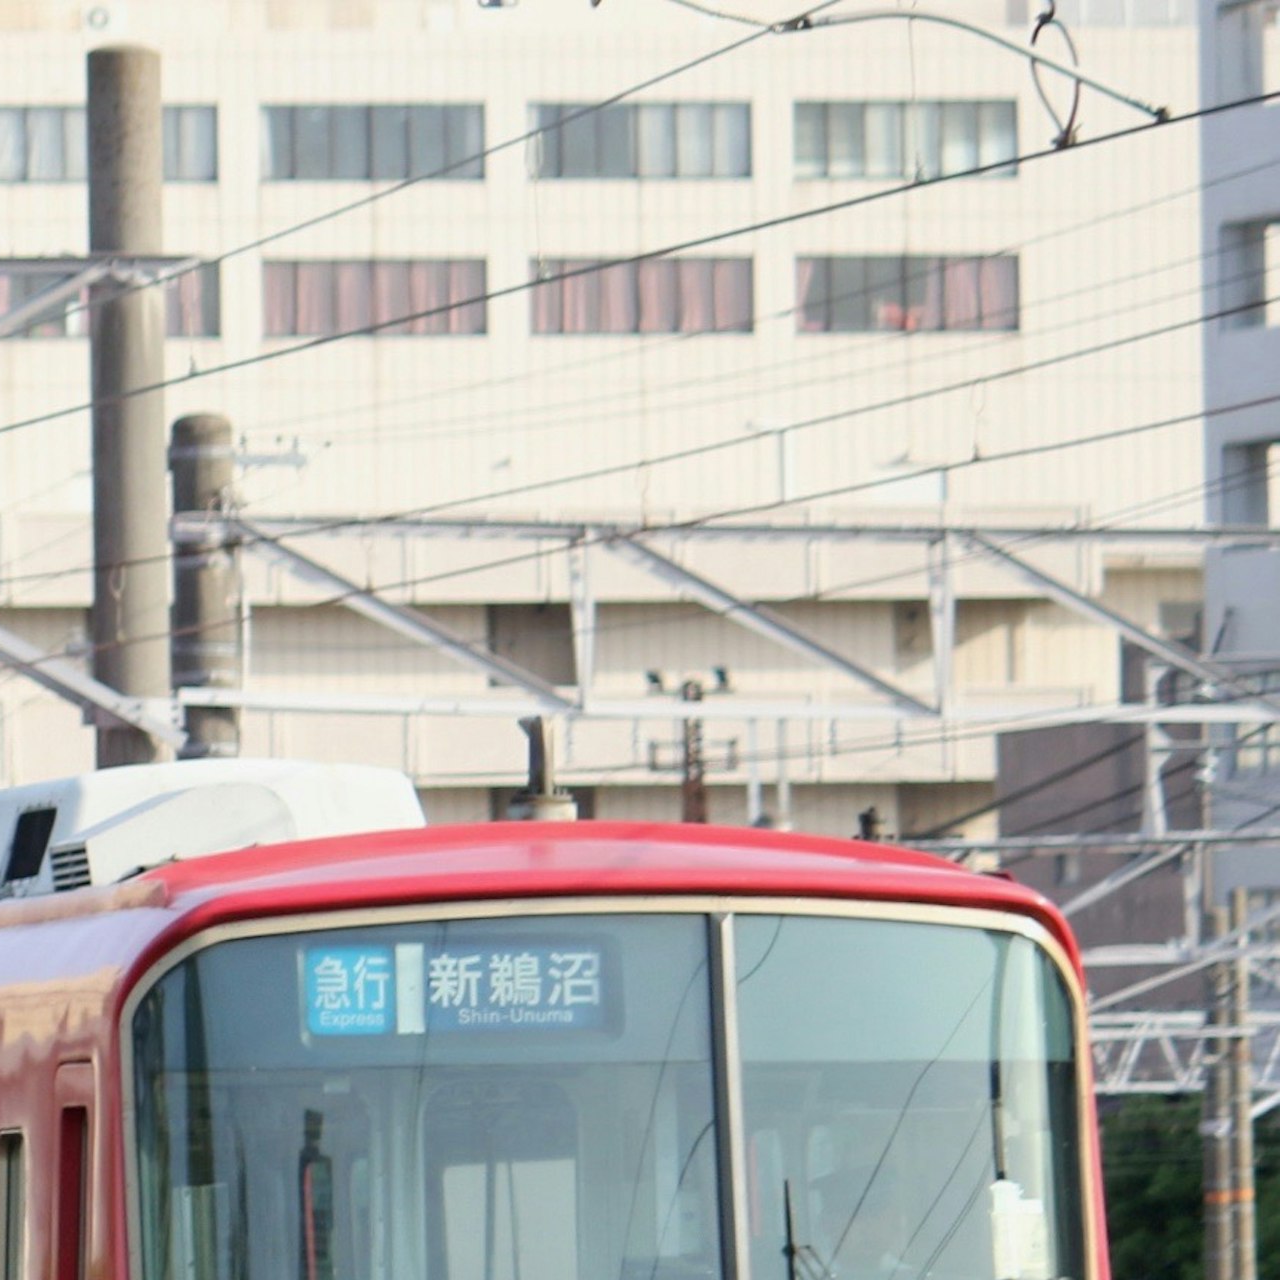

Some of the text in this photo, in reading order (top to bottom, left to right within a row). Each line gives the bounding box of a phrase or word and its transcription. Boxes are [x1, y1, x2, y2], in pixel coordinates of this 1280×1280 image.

[314, 956, 389, 1010] 急行
[429, 951, 601, 1008] 新鵜沼
[319, 1012, 385, 1028] Express
[458, 1007, 574, 1026] Shin-Unuma
